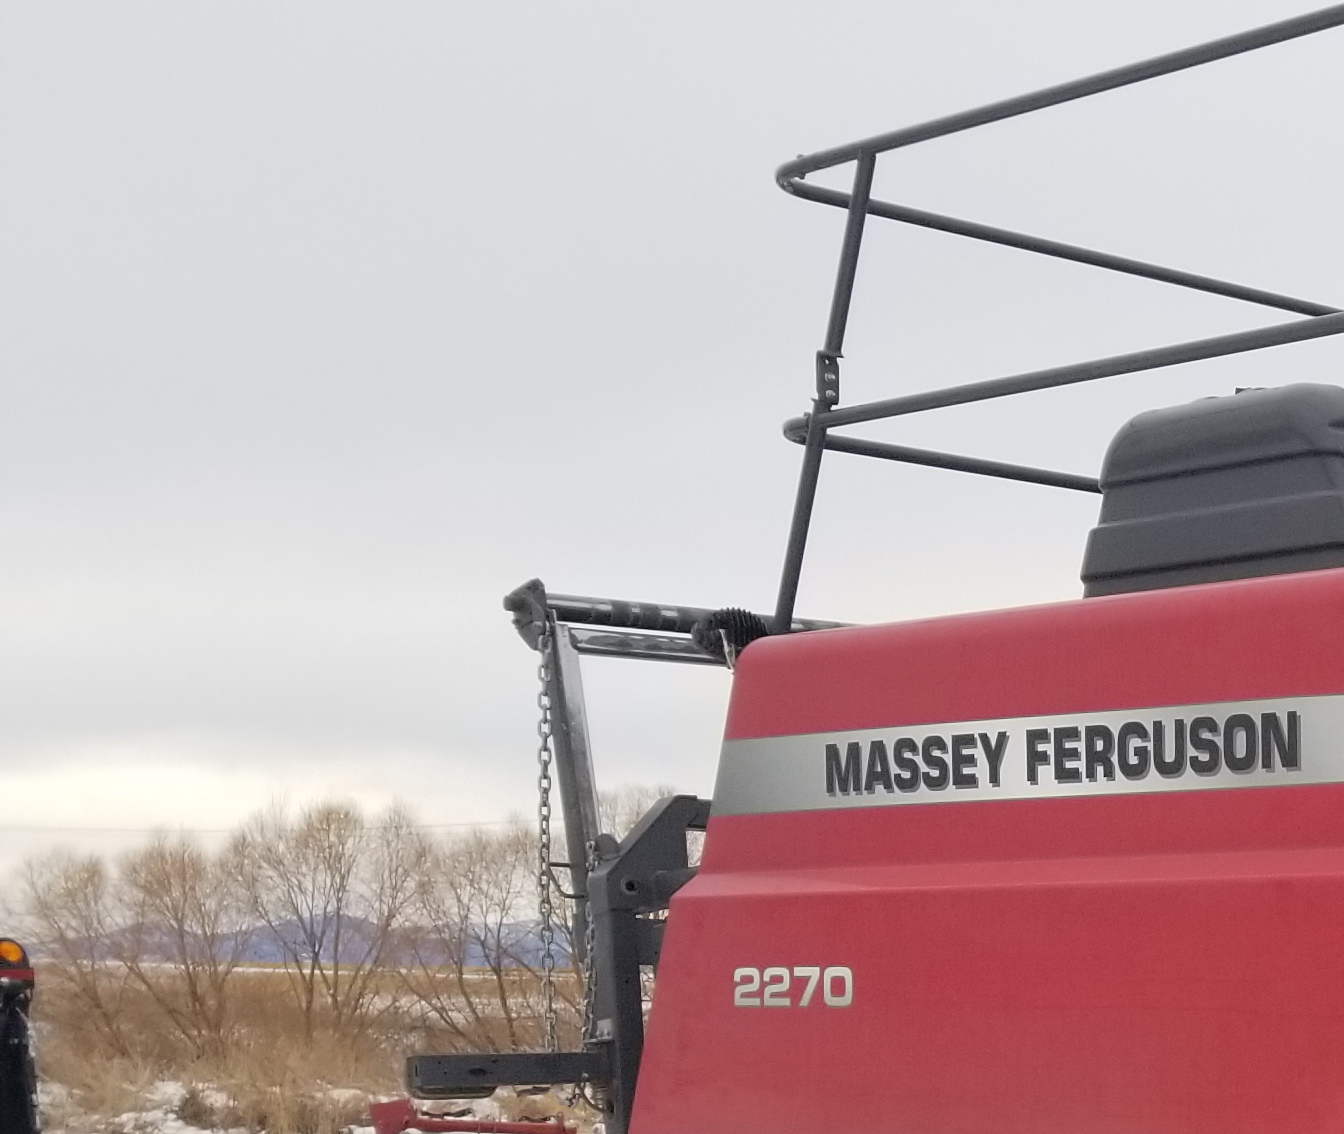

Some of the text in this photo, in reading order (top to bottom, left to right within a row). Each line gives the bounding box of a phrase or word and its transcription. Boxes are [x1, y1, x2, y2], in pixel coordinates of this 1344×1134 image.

[825, 710, 1302, 797] MASSEY FERGUSON
[733, 966, 853, 1007] 2270
